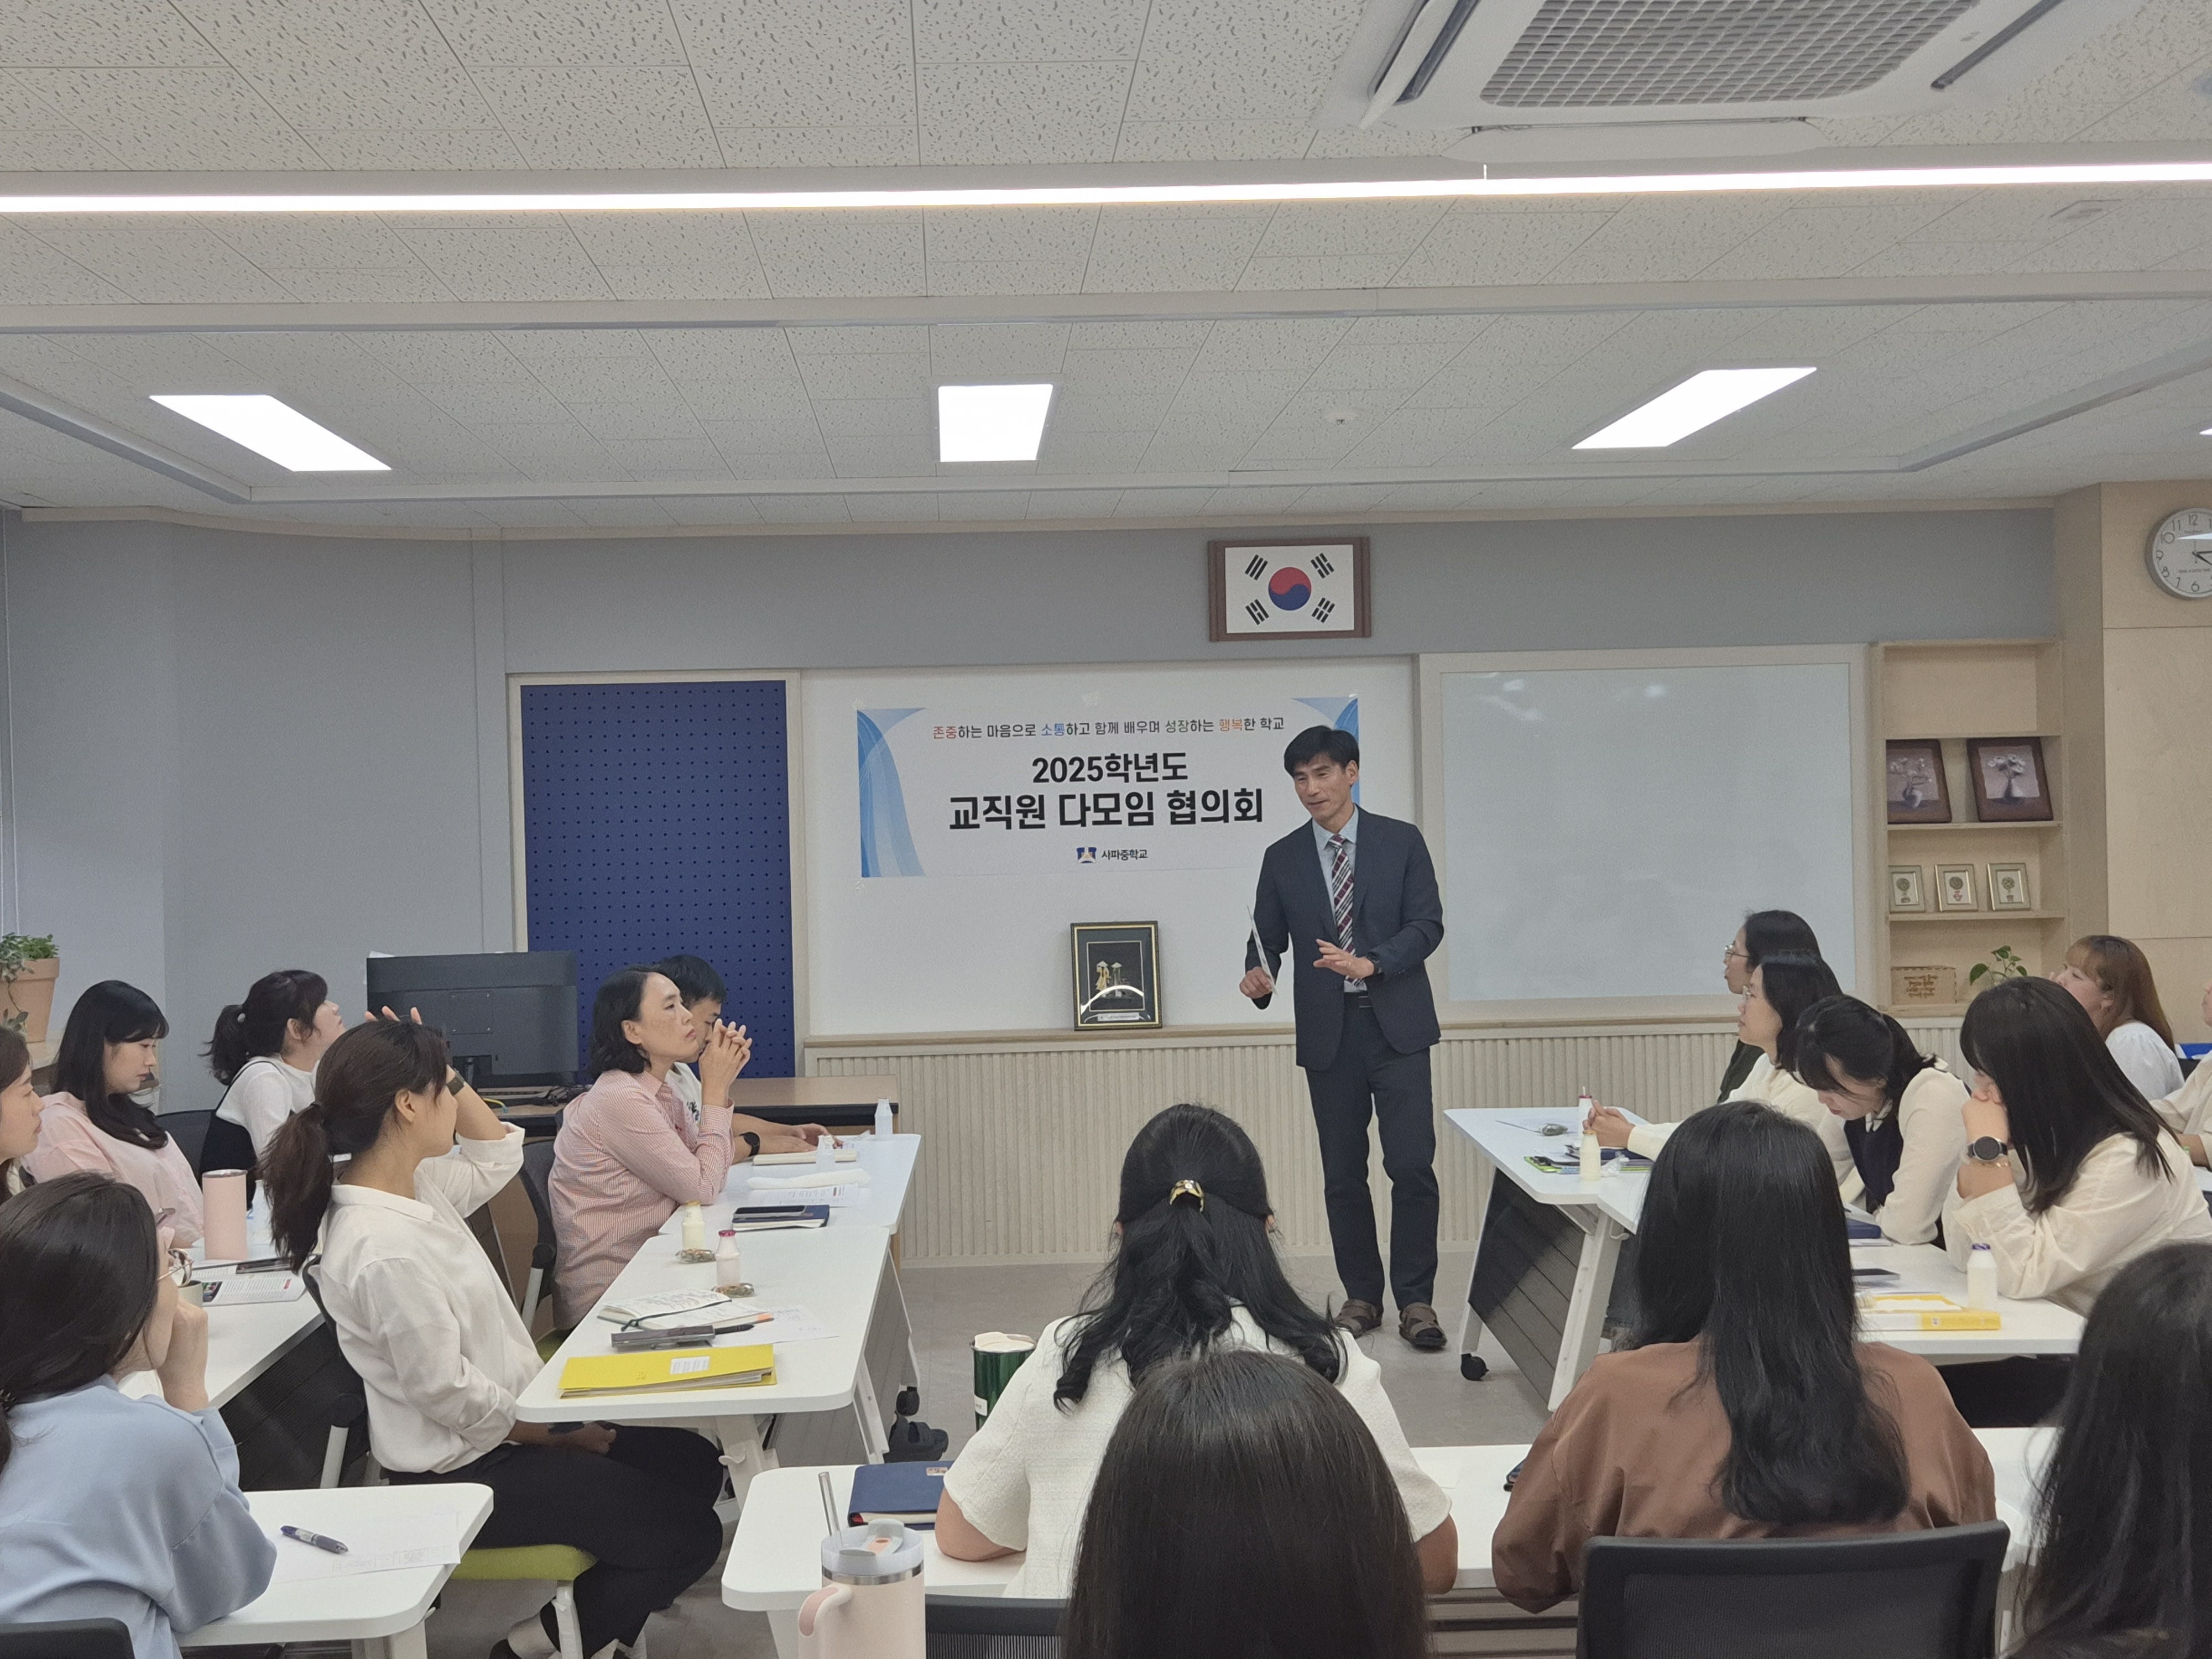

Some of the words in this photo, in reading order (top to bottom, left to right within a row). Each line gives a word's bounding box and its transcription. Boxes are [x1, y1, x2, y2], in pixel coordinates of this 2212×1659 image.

[2172, 519, 2180, 531] 11
[2188, 514, 2198, 525] 12
[2161, 531, 2175, 544] 10
[2162, 566, 2169, 578] 8
[2176, 577, 2181, 589] 7
[2191, 581, 2199, 592] 6
[933, 726, 982, 739] 존중하는
[987, 724, 1036, 738] 마음으로
[1041, 722, 1090, 736] 소통하고
[1095, 722, 1119, 735] 함께
[1124, 721, 1160, 734] 배우며
[1165, 719, 1214, 733] 성장하는
[1219, 718, 1256, 732] 행복한
[1260, 717, 1284, 731] 학교
[1032, 753, 1188, 783] 2025학년도
[950, 794, 1046, 830] 교직원
[1059, 791, 1155, 827] 다모임
[1167, 788, 1262, 825] 협의회
[1101, 849, 1148, 860] 사파중학교
